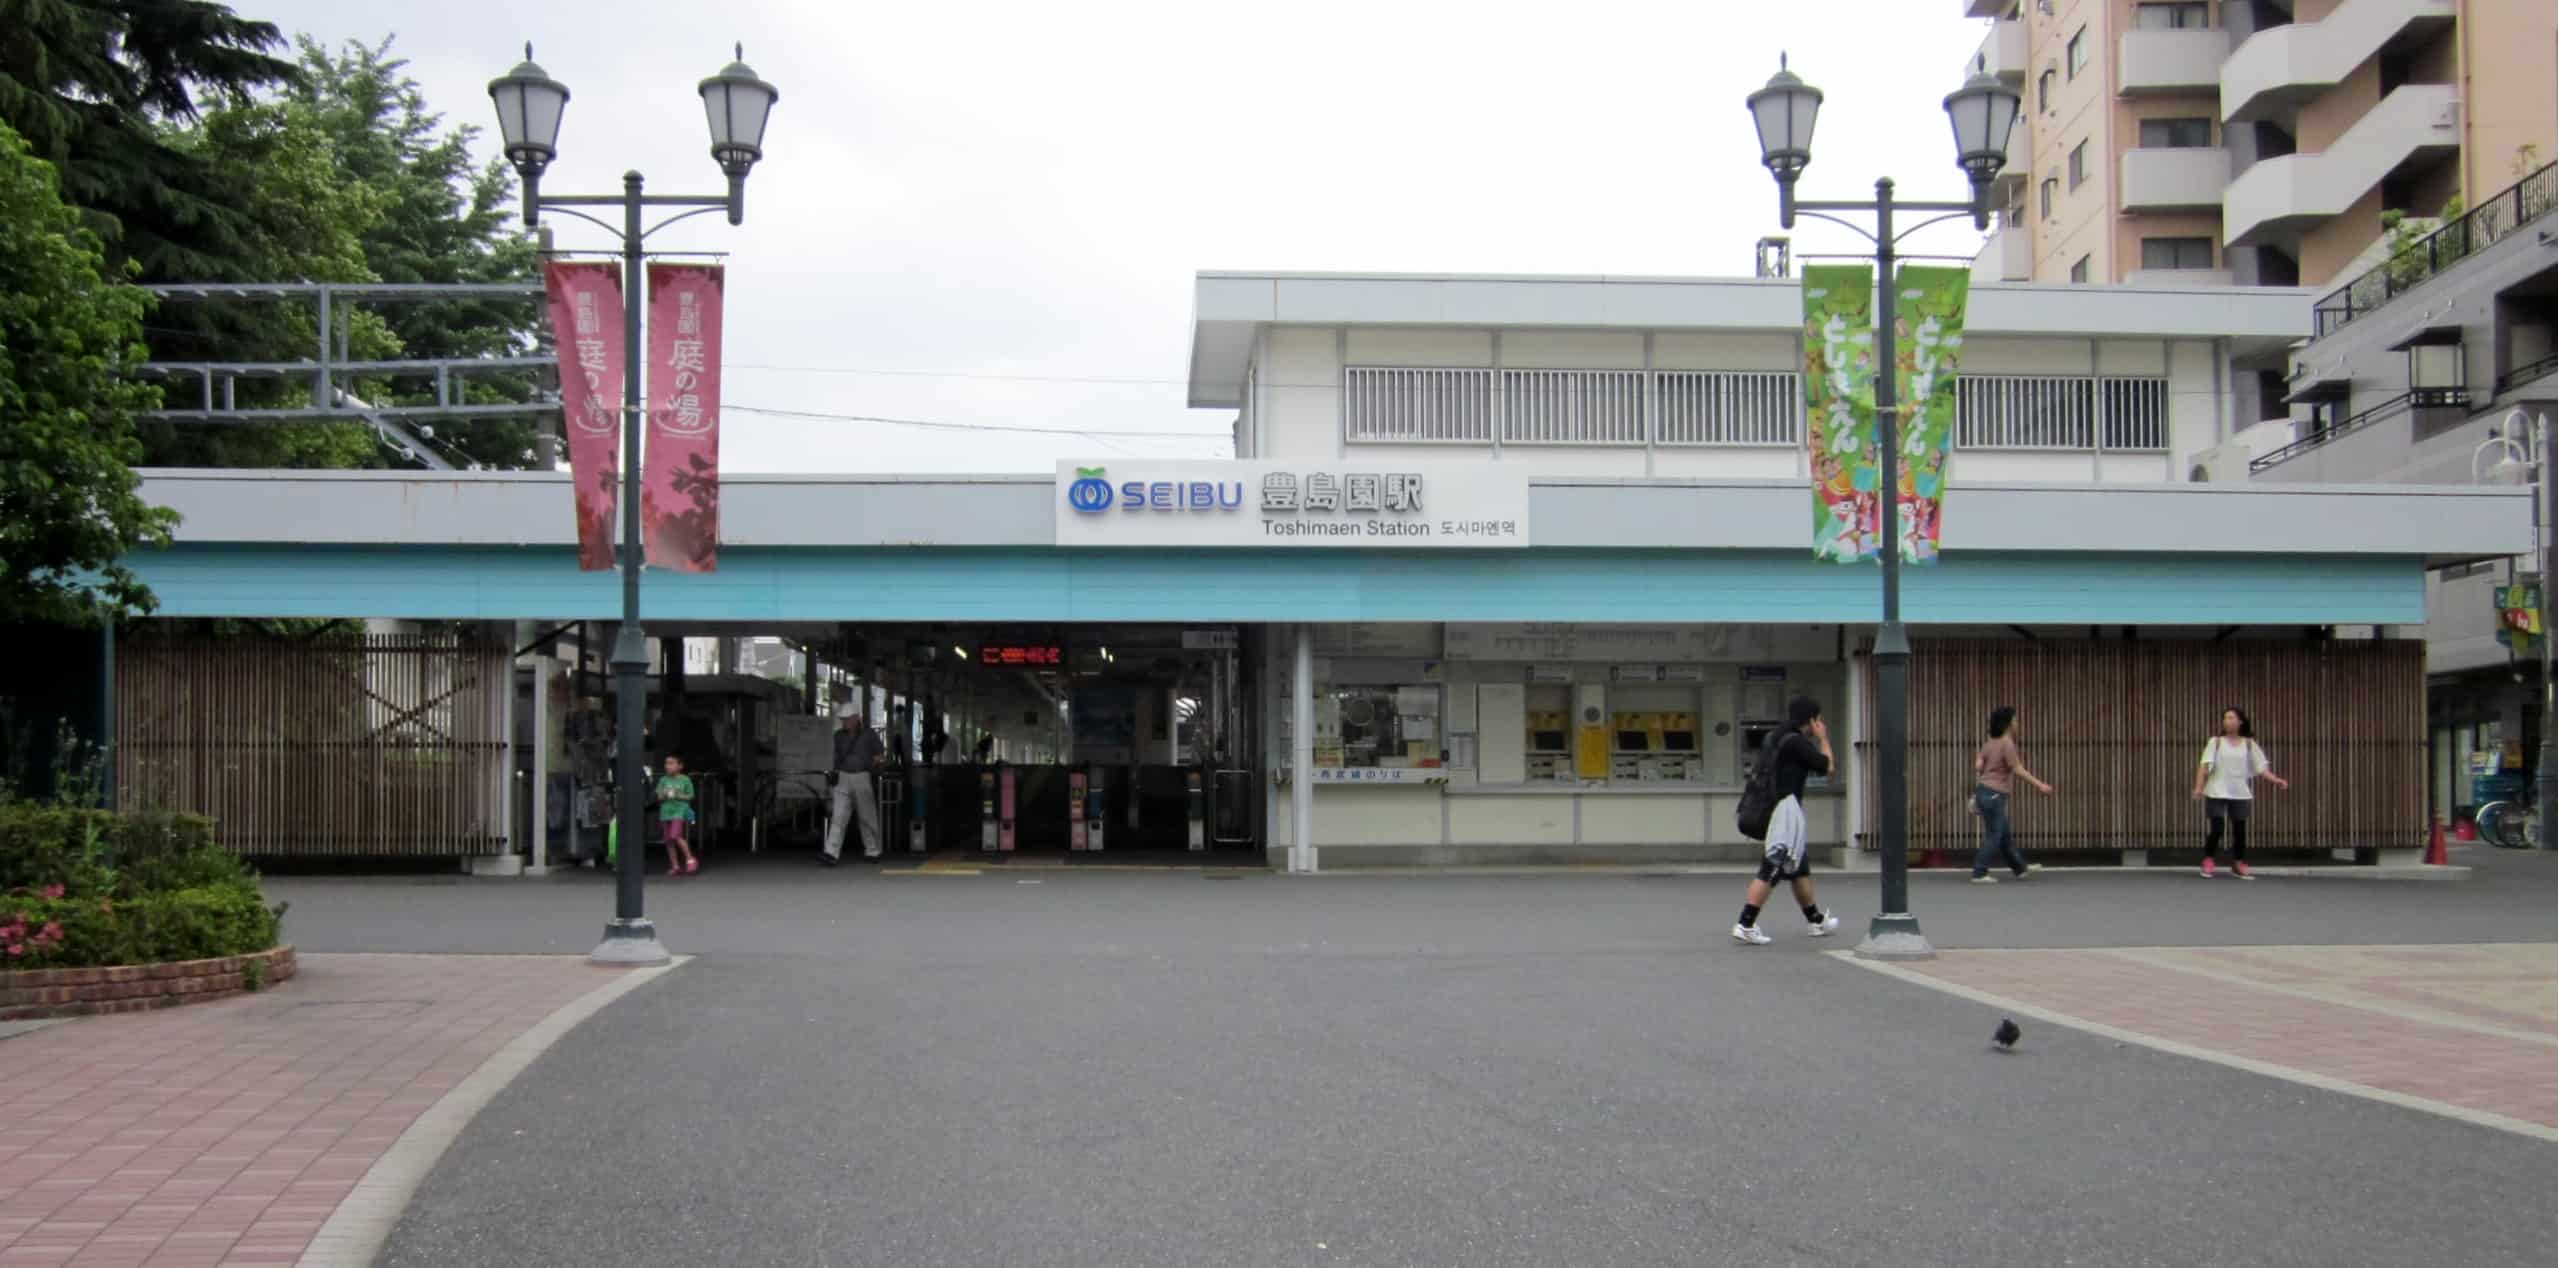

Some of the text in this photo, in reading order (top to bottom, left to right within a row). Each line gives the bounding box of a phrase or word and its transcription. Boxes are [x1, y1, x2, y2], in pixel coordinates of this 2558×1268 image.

[667, 339, 705, 427] 庭の湯
[1121, 481, 1243, 511] SEIBU
[1260, 472, 1424, 513] 豊島園駅
[1263, 520, 1430, 537] Toshimaen Station
[1440, 520, 1516, 537] 도시마엔역
